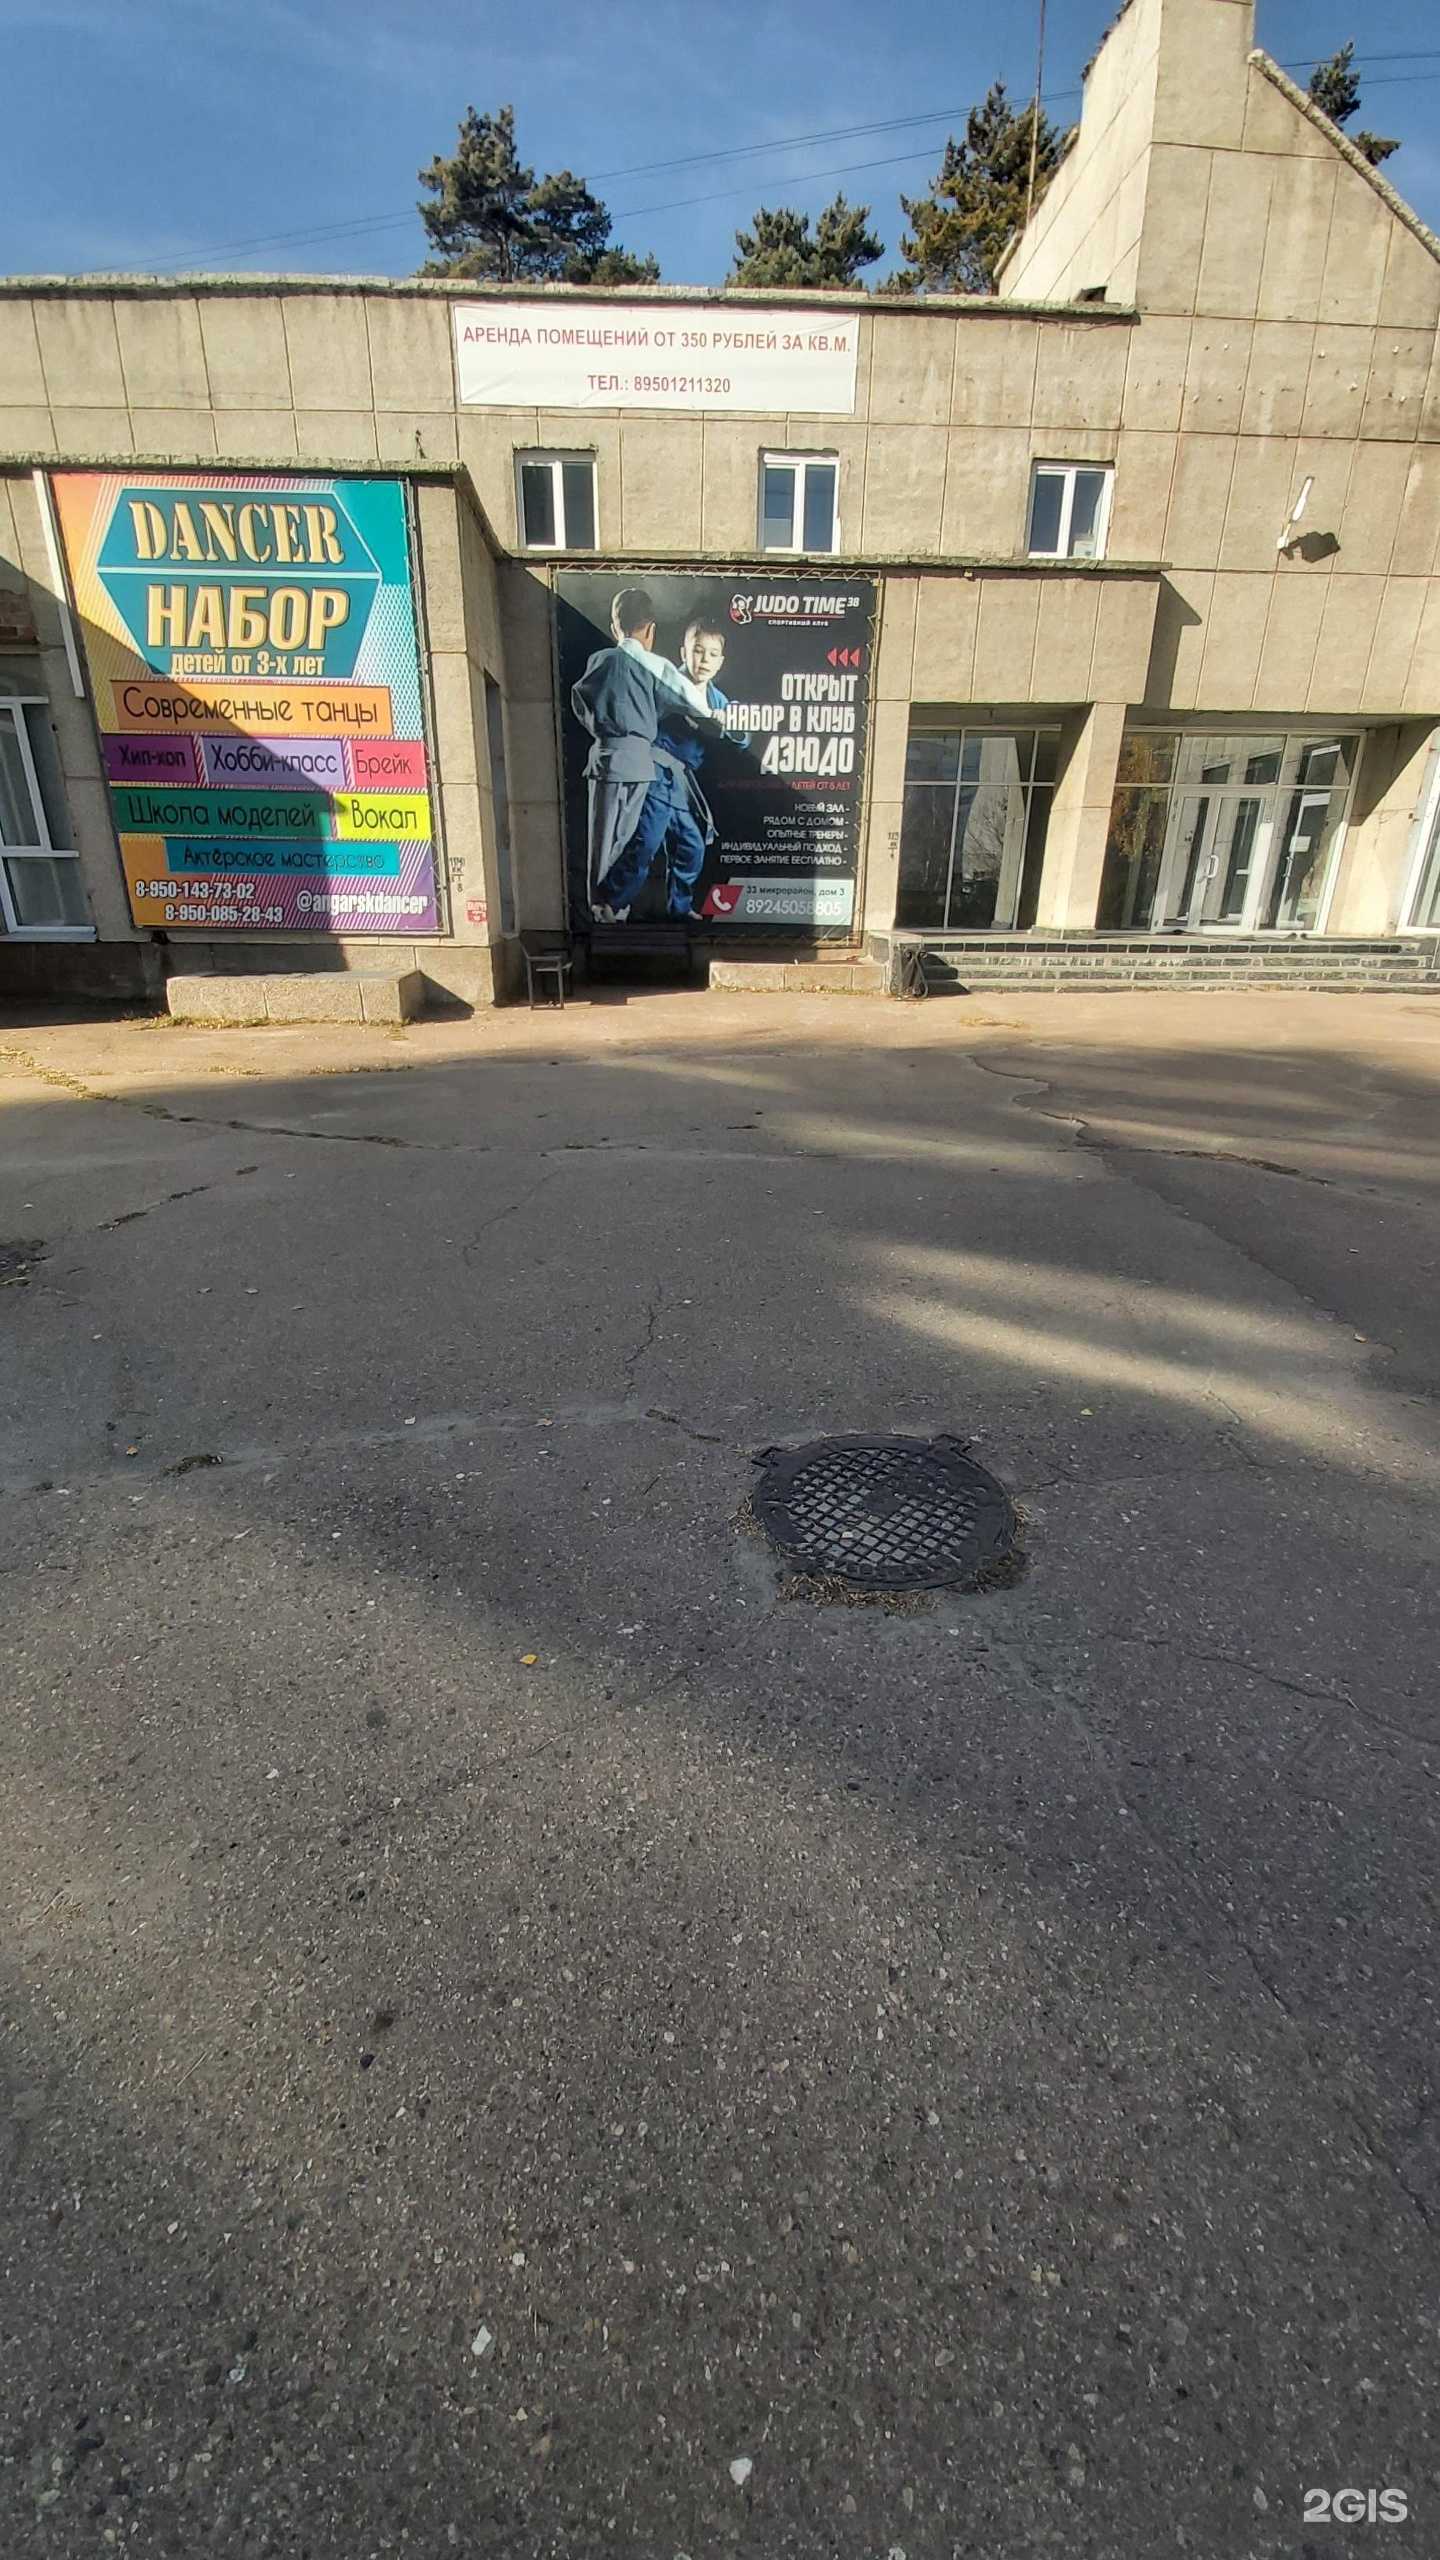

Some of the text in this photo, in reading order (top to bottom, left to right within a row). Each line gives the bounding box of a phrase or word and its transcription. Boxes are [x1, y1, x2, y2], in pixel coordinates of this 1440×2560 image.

[464, 327, 532, 346] АРЕНДА
[538, 328, 649, 347] ПОМЕЩЕНИЙ
[654, 331, 676, 347] ОТ
[681, 332, 707, 348] 350
[713, 331, 777, 350] РУБЛЕЙ
[782, 334, 803, 350] ЗА
[634, 377, 731, 393] 89501211320
[128, 501, 346, 564] DANCER
[147, 584, 350, 651] НАБОР
[753, 595, 800, 614] JUDO
[802, 596, 847, 615] TIME
[171, 648, 325, 676] детей от 3-х лет
[781, 673, 858, 702] ОТКРЫТ
[123, 686, 378, 729] Современные танцы
[726, 704, 856, 733] НАБОР В КЛУБ
[118, 743, 186, 768] Хип-хоп
[210, 744, 338, 773] Хобби-класс
[354, 748, 412, 778] Брейк
[760, 735, 855, 776] ДЗЮДО
[127, 795, 315, 835] Школа моделей
[352, 800, 417, 829] Вокал
[795, 802, 845, 813] НОВЫЙ ЗАЛ
[763, 815, 844, 826] РЯДОМ С ДОМОМ
[721, 840, 842, 854] ИНДИВИДУАЛЬНЫЙ ПОДХОД
[767, 829, 844, 840] ОПЫТНЫЕ ТРЕНЕРЫ
[281, 852, 386, 871] мастерство
[720, 854, 842, 866] ПЕРВОЕ ЗАНЯТИЕ БЕСПЛАТНО
[296, 890, 428, 915] @angarskdancer
[818, 888, 837, 896] дом
